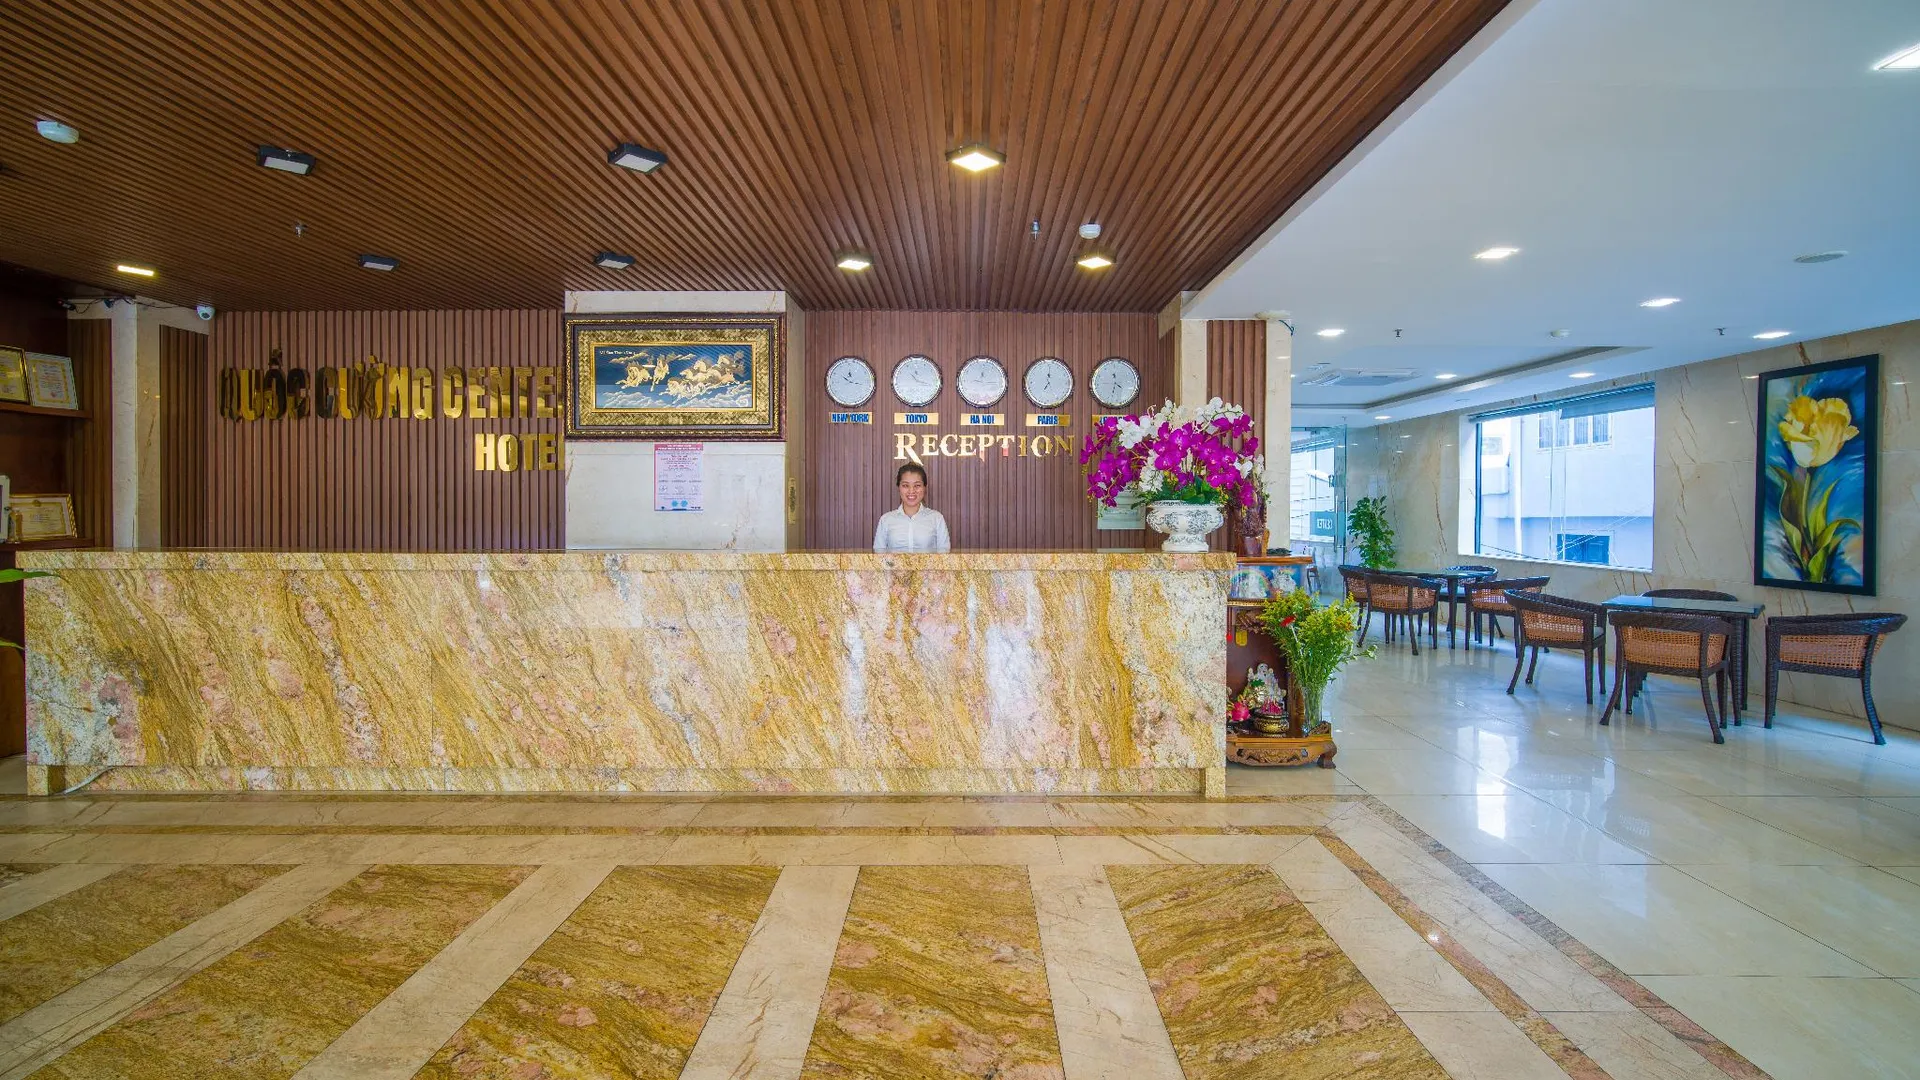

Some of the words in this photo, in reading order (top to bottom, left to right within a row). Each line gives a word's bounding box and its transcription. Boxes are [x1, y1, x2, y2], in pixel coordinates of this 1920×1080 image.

[441, 365, 564, 419] CENTE
[905, 413, 928, 424] TOKYO
[970, 414, 980, 424] HA
[1037, 415, 1058, 425] PARIS
[894, 433, 1075, 466] RECEPTION
